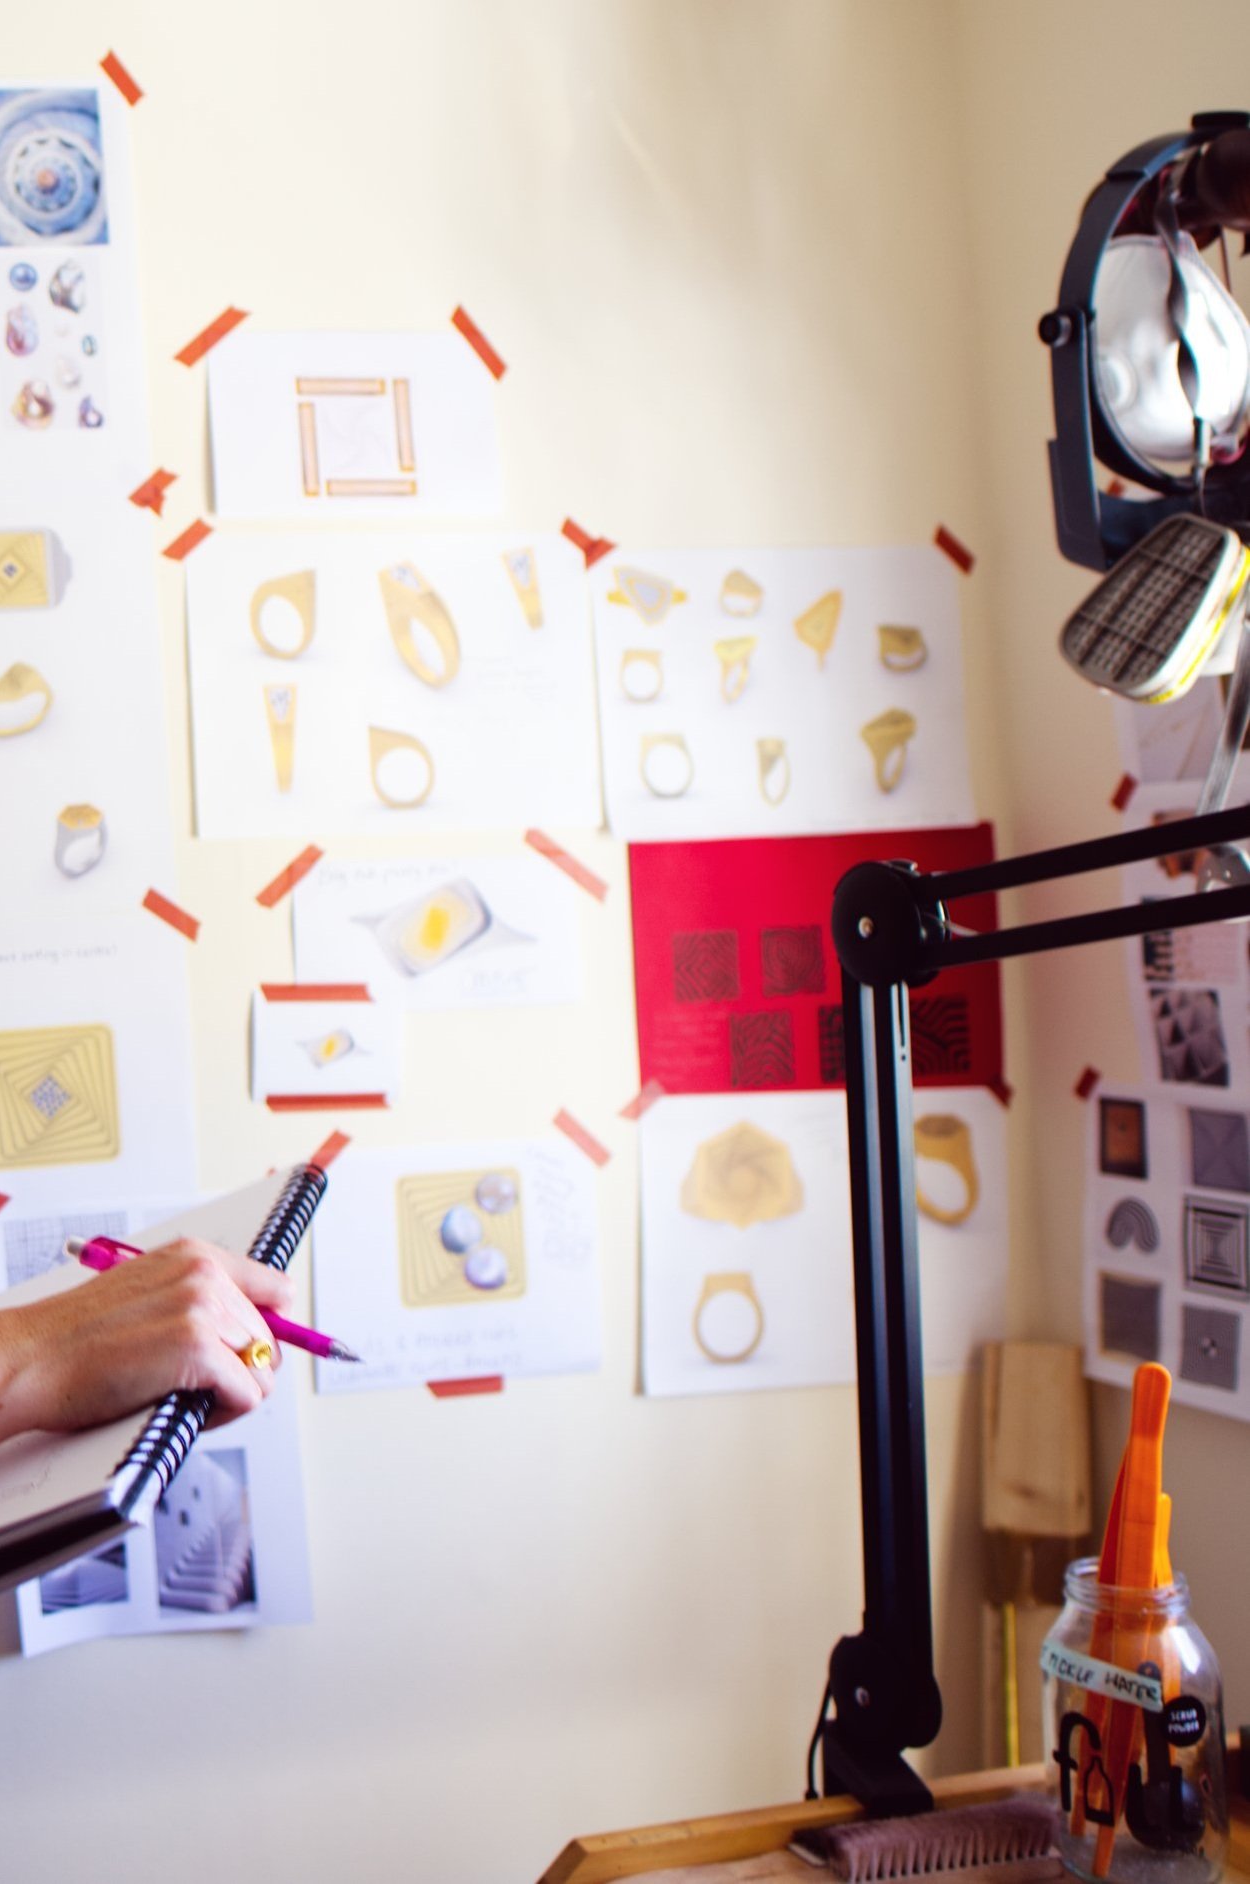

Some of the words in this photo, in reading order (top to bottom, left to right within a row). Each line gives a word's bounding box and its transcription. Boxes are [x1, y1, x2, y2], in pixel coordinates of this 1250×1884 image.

[1104, 1670, 1159, 1703] WATER
[1170, 1708, 1198, 1722] SCRUB
[1167, 1720, 1200, 1735] POWDER
